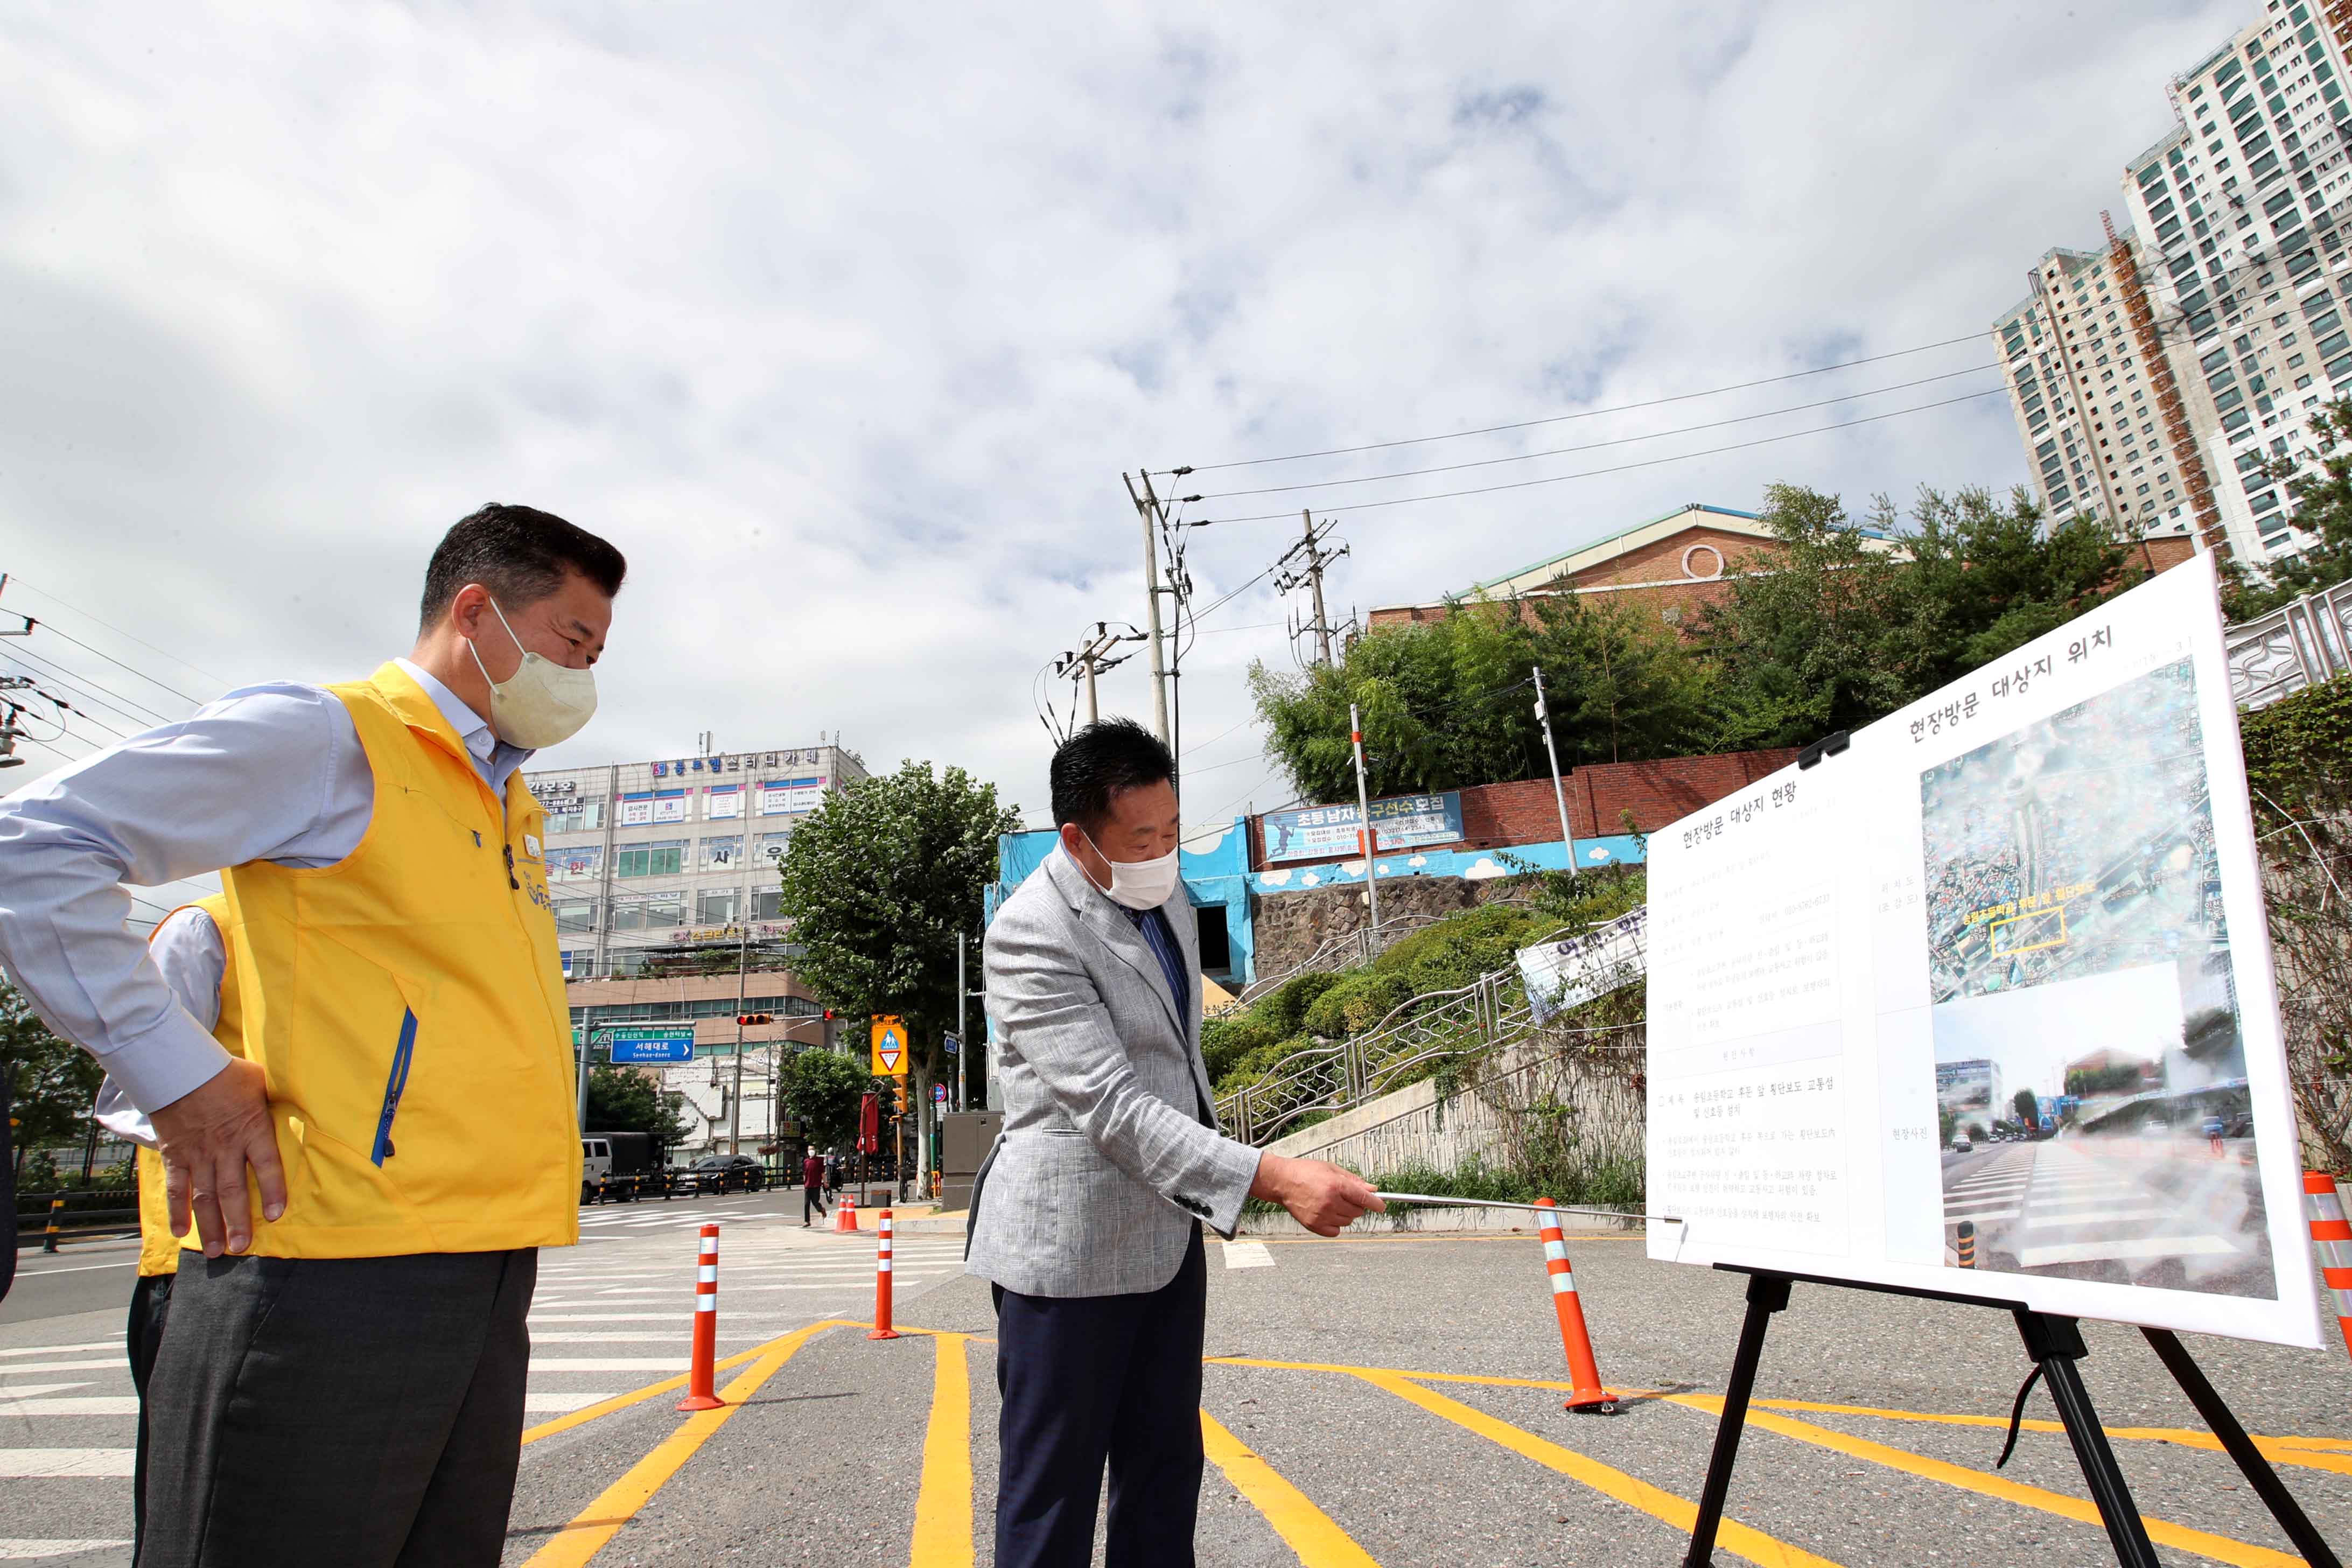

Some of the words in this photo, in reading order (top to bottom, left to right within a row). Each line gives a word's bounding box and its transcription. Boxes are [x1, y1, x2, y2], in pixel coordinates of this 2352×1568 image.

[1909, 691, 1980, 743] 현장방문
[1992, 656, 2053, 698] 대상지
[2067, 625, 2113, 663] 위치
[1297, 811, 1324, 827] 초등
[1327, 807, 1355, 823] 남자
[1415, 796, 1444, 811] 모집
[1683, 816, 1724, 850] 현장방문
[1730, 796, 1764, 824] 대상지
[1772, 780, 1797, 808] 현황
[713, 850, 730, 864] 사
[766, 846, 783, 860] 우
[1963, 902, 2014, 925] 송림초등학교
[635, 1042, 669, 1051] 서해대로
[1693, 1088, 1734, 1103] 송림초등학교
[1738, 1085, 1753, 1098] 후문
[1770, 1081, 1802, 1096] 횡단보도
[1808, 1075, 1833, 1091] 교통섬
[1703, 1105, 1723, 1119] 신호등
[1727, 1102, 1741, 1117] 설치
[1892, 1125, 1928, 1141] 현장사진
